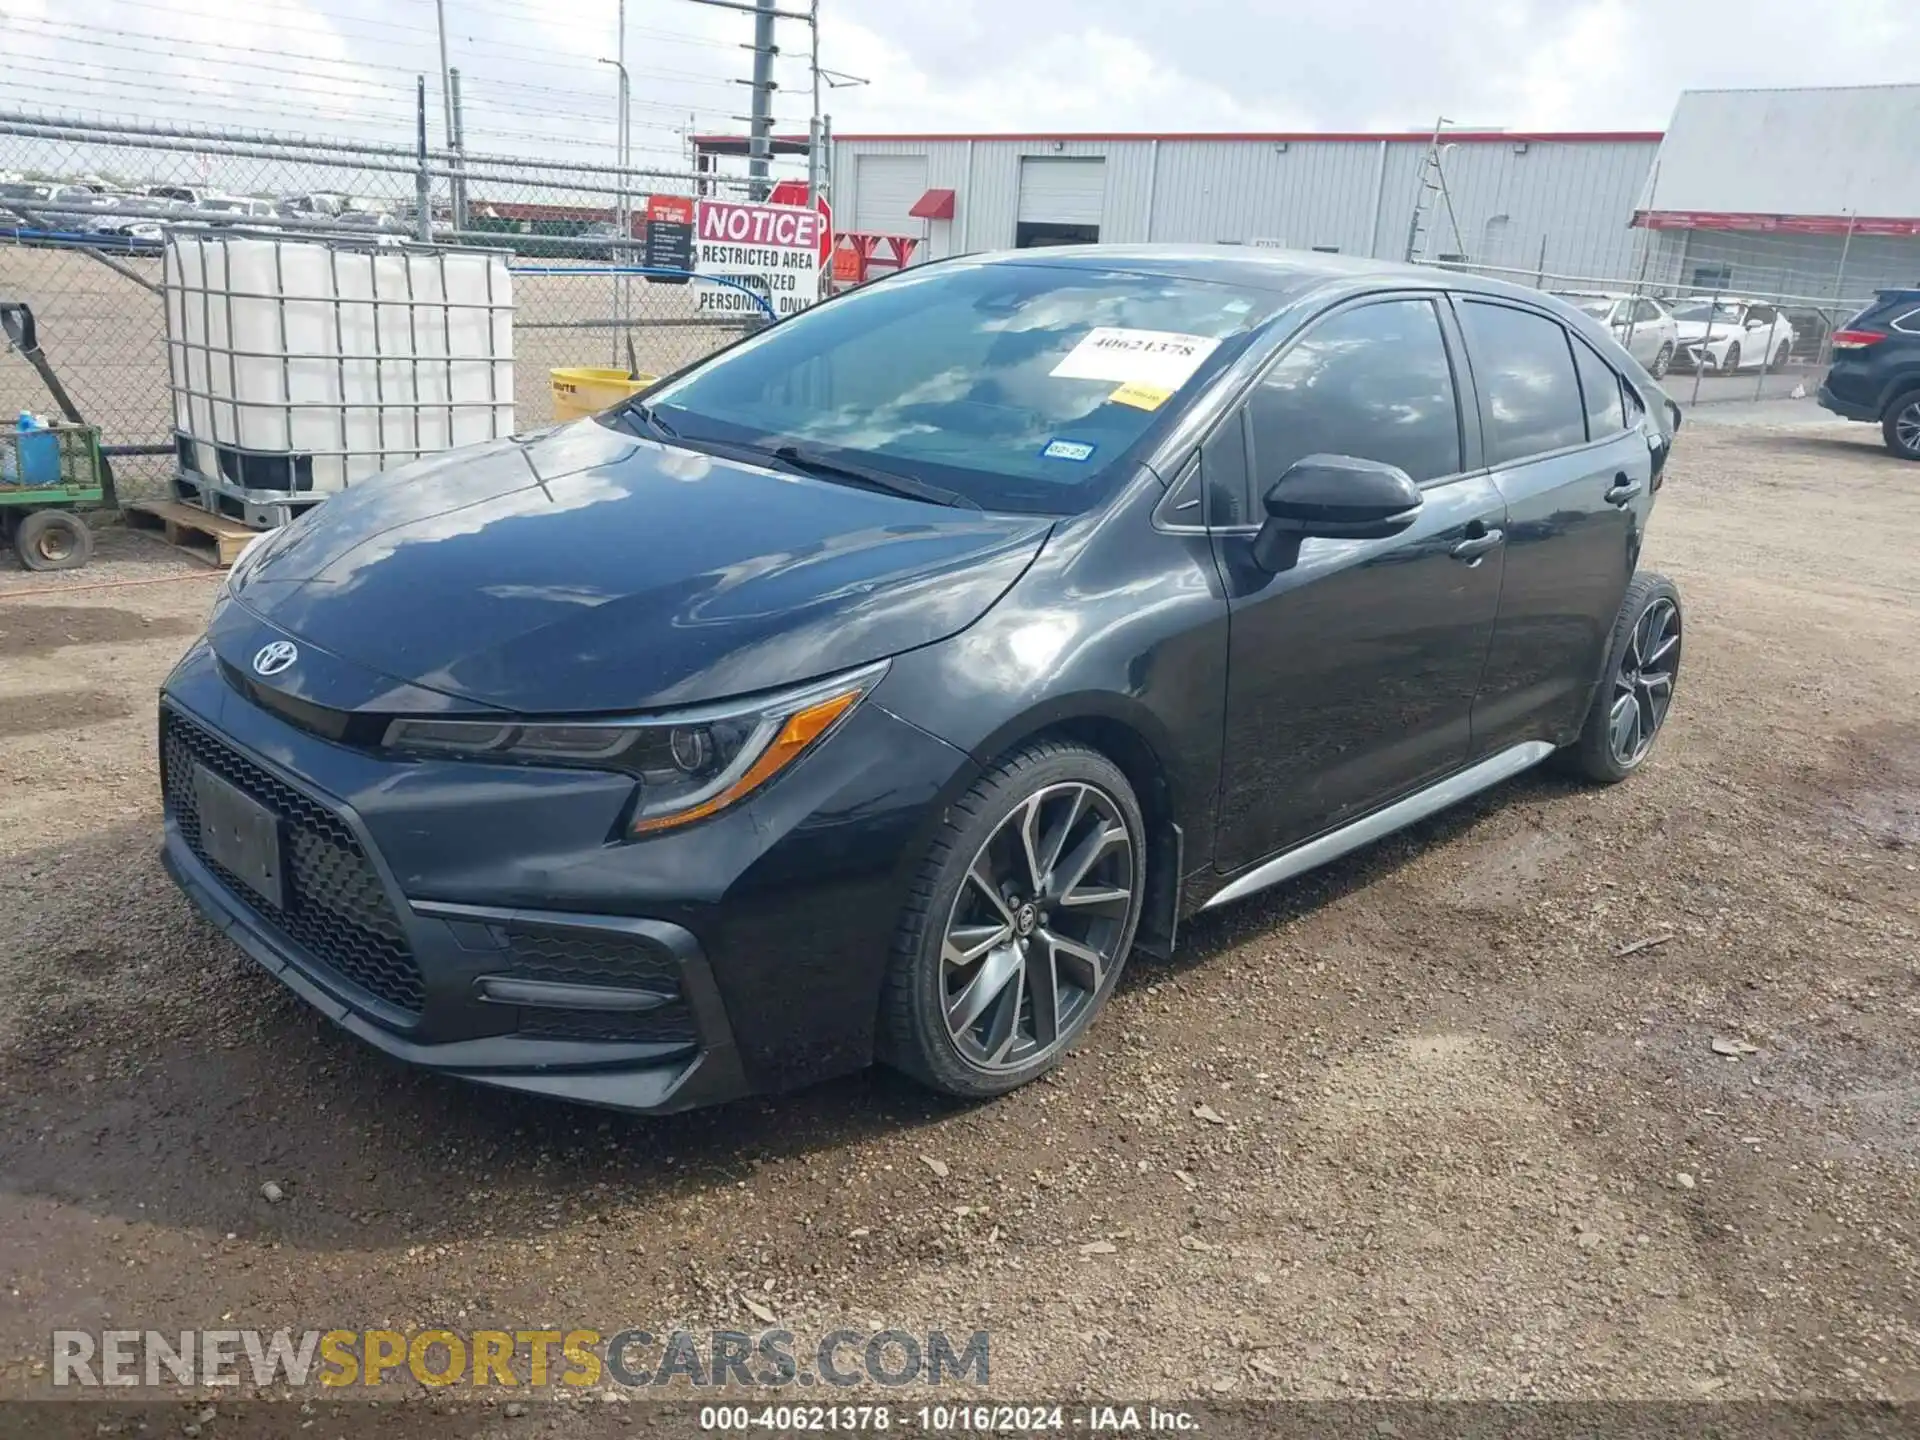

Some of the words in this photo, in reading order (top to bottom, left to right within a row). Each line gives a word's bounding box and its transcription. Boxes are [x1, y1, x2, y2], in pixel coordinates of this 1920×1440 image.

[704, 206, 814, 245] NOTICE
[702, 245, 779, 267] RESTRICTED
[782, 251, 812, 269] AREA
[700, 292, 773, 312] PERSONNE
[1093, 338, 1196, 356] 40621378
